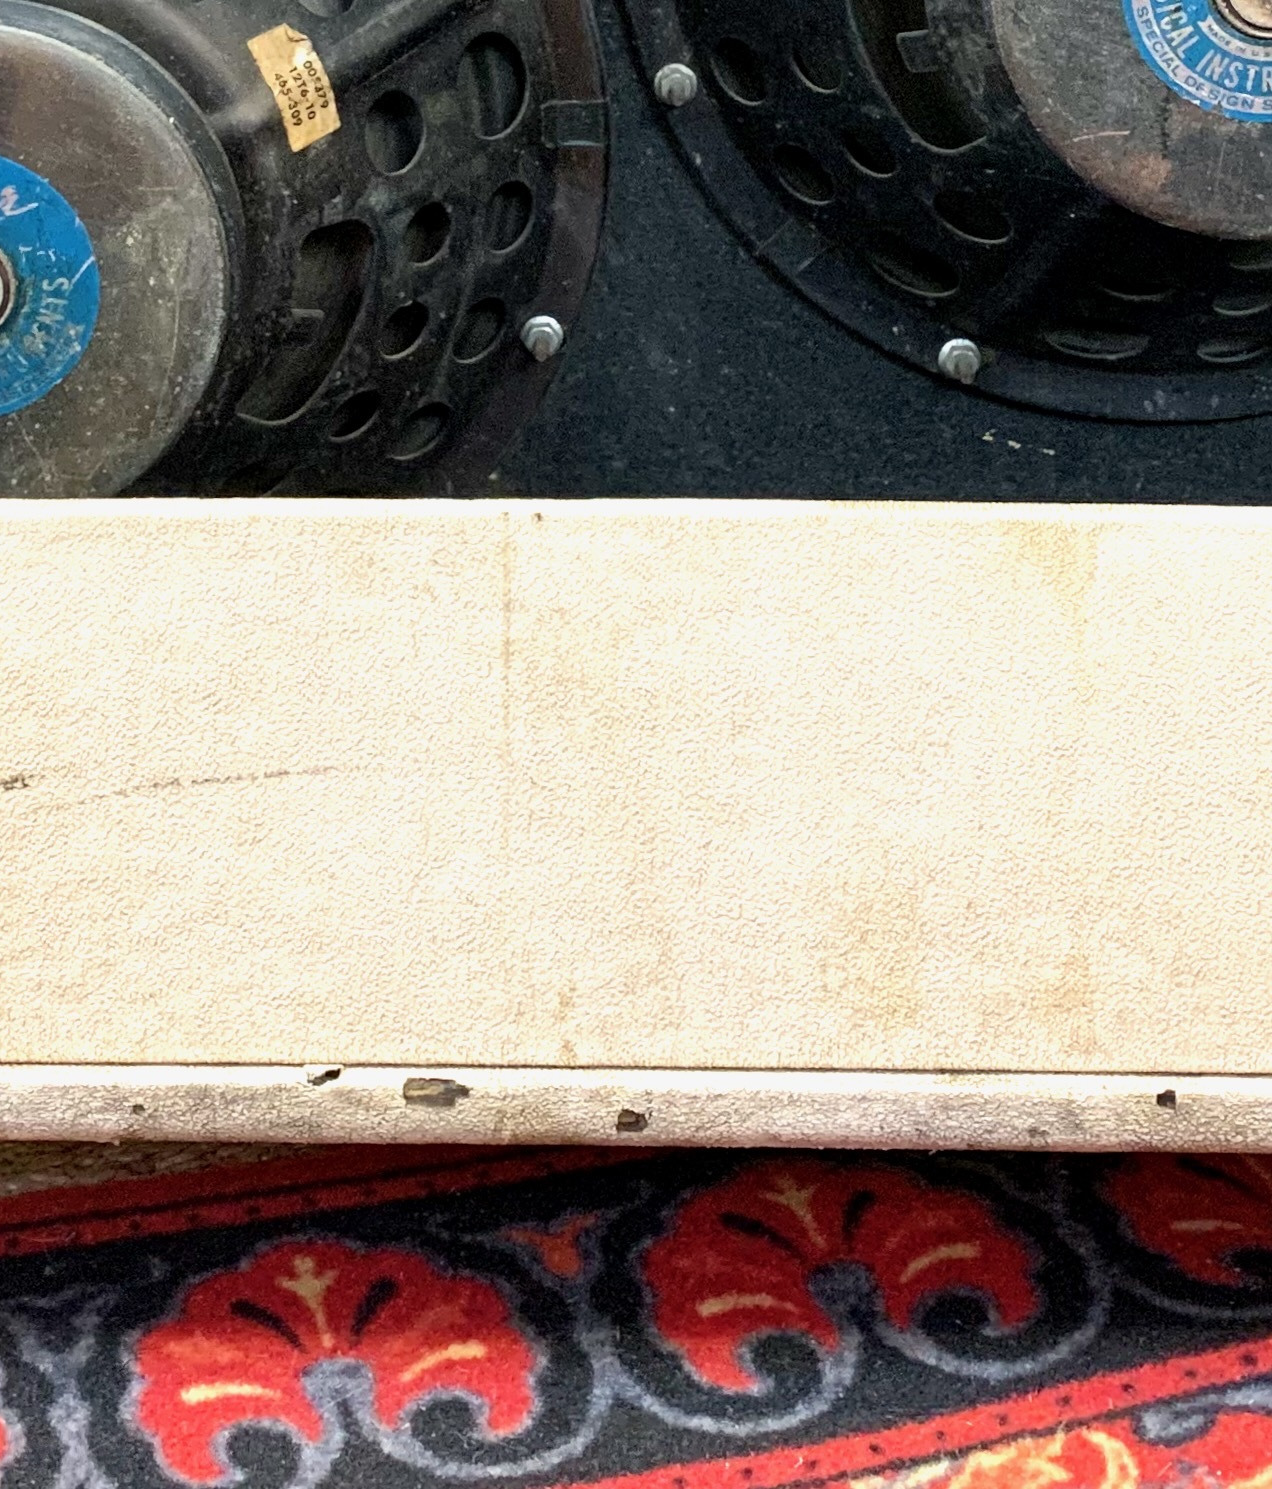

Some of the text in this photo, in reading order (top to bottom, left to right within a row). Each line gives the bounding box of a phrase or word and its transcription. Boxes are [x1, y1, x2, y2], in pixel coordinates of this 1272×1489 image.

[1136, 4, 1186, 78] SPECIAL
[1183, 73, 1255, 110] DESIGN
[273, 72, 304, 127] 465-309
[288, 66, 317, 121] 12T6-10
